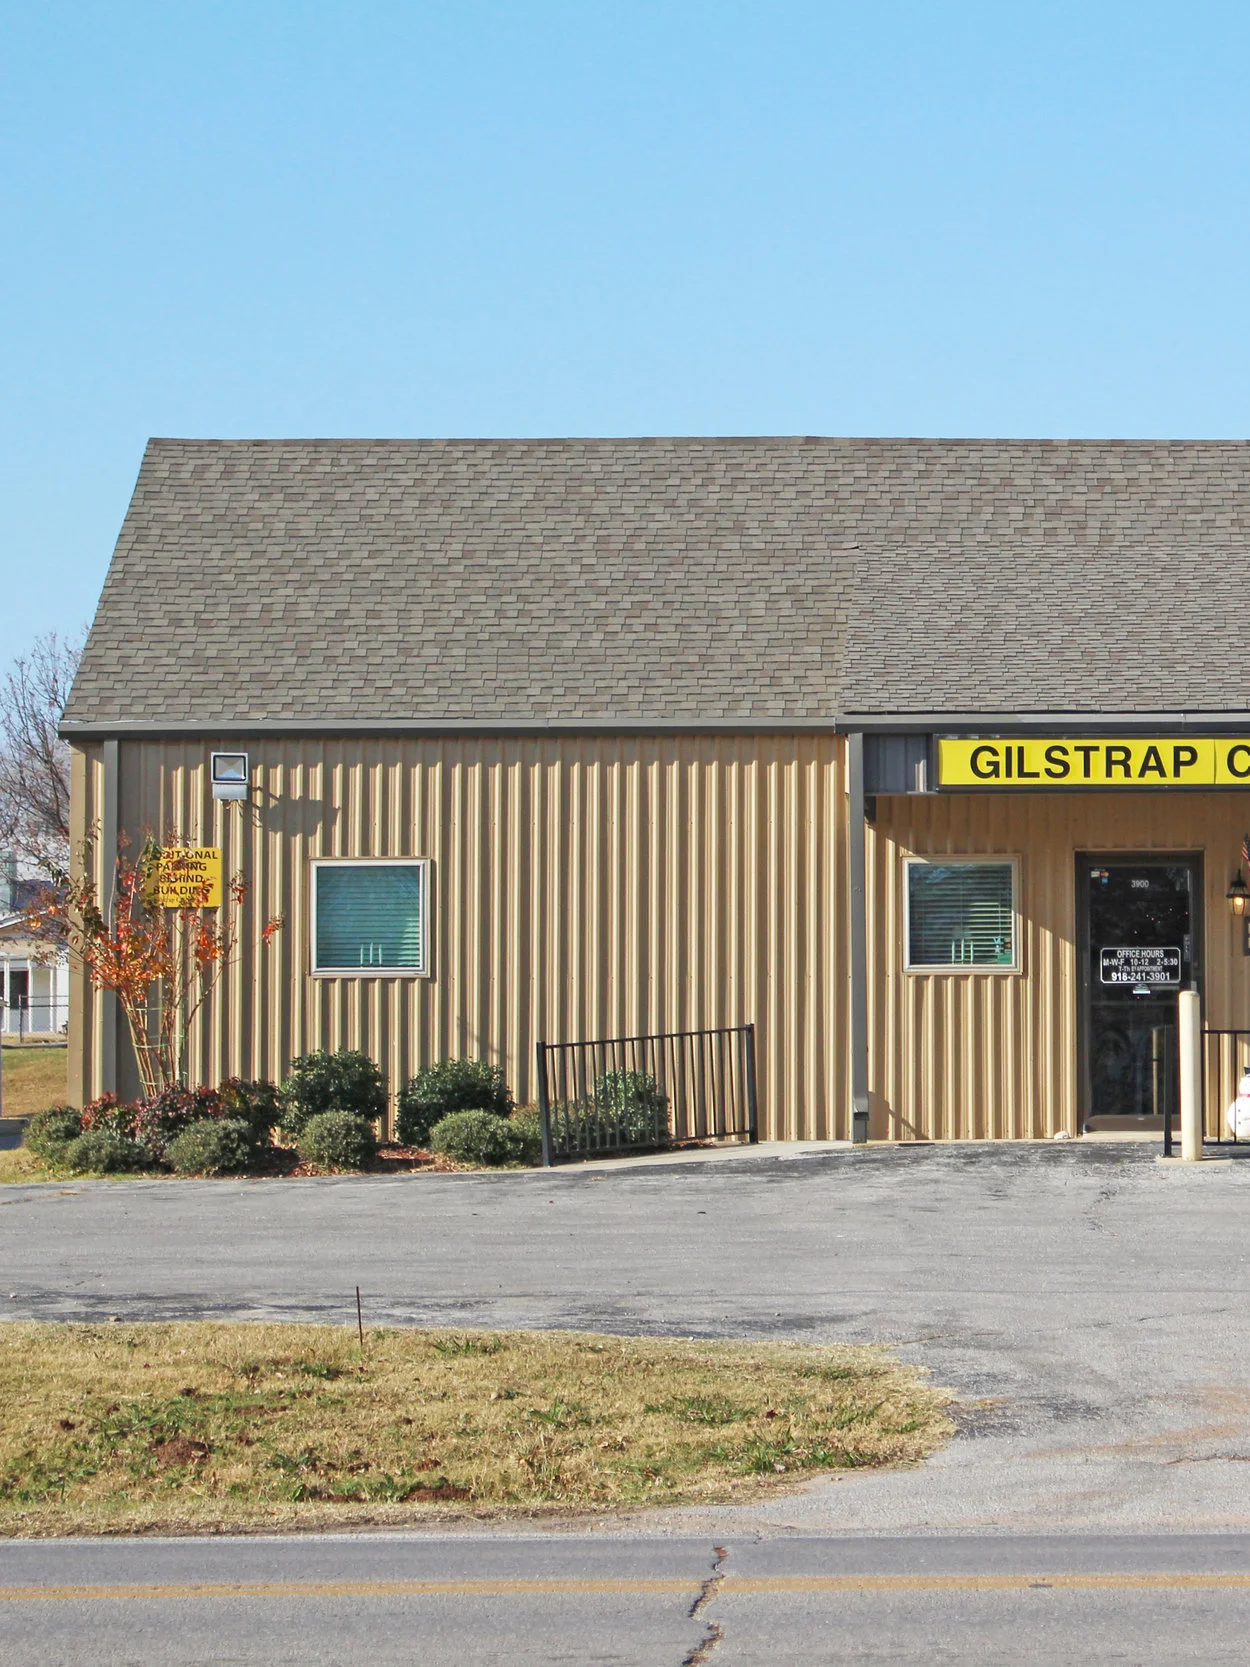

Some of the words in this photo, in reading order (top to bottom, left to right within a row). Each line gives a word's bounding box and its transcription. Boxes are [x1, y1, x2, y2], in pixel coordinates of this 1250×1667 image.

[969, 744, 1198, 779] GILSTRAP
[1131, 880, 1149, 888] 3900
[1116, 950, 1140, 958] OFFICE
[1141, 950, 1164, 958] HOURS
[1111, 972, 1170, 981] 918-241-3901
